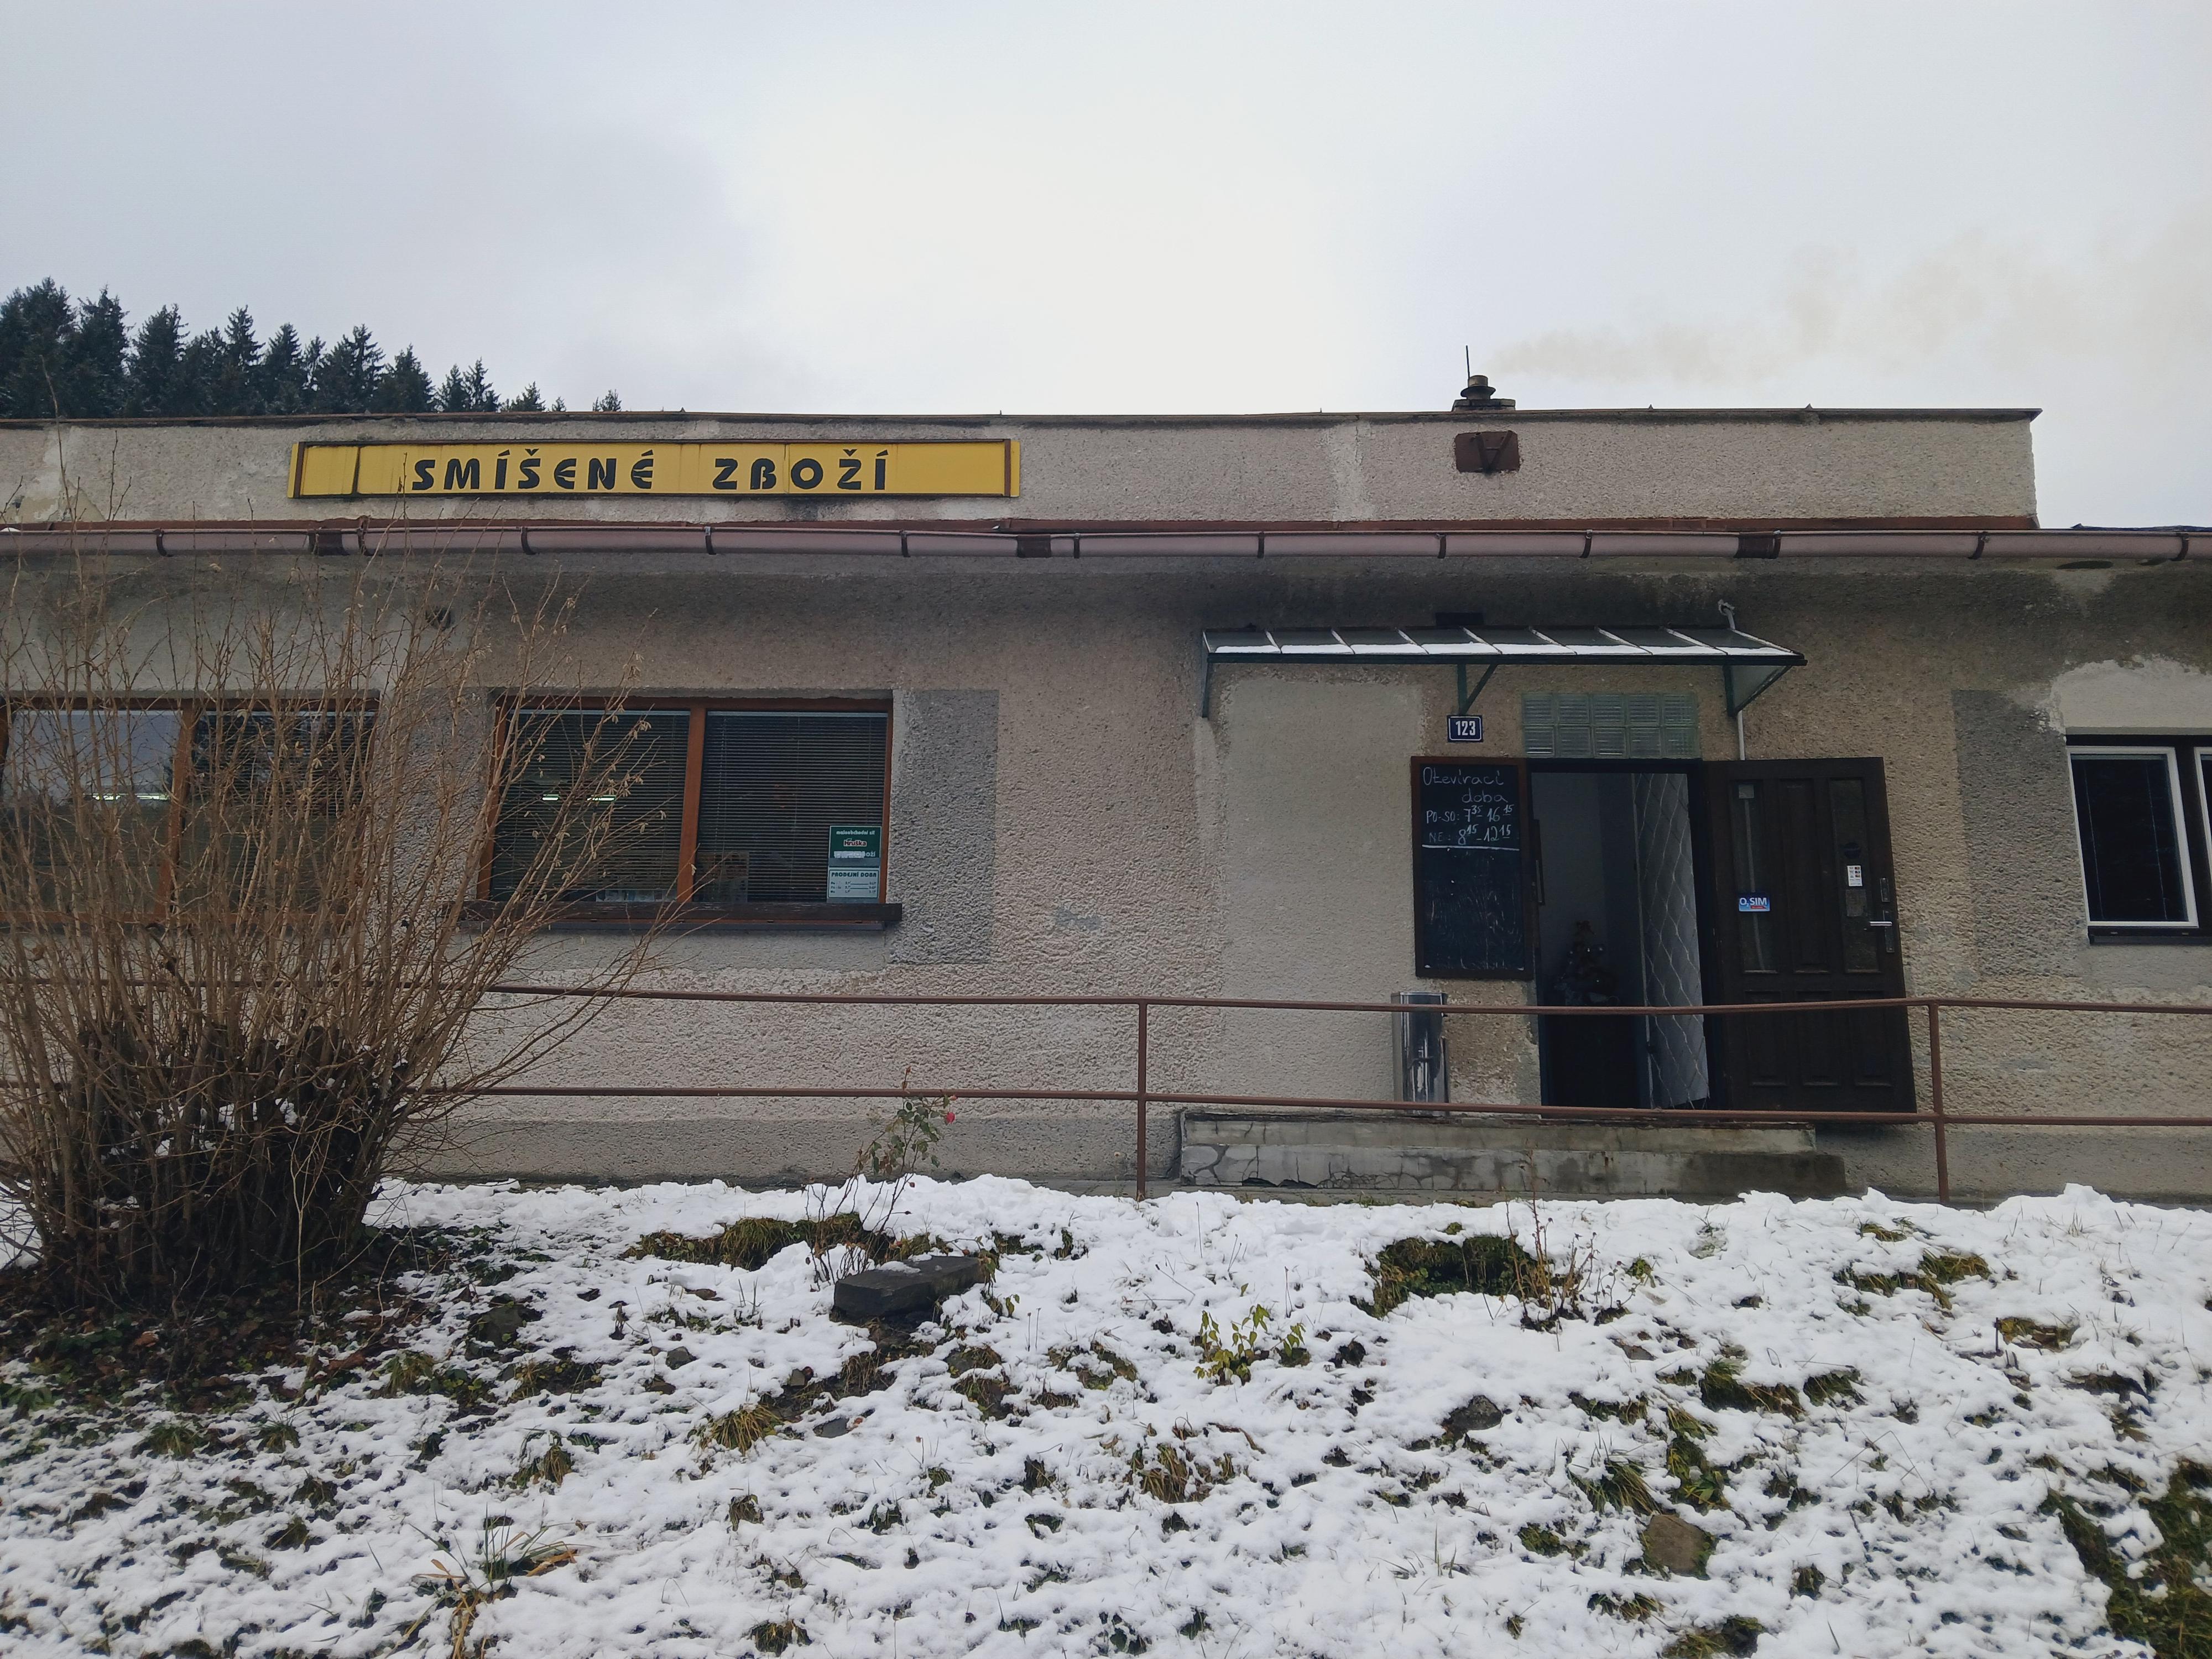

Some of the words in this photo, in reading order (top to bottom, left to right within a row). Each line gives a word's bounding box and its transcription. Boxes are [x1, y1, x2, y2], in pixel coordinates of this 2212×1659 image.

[411, 448, 654, 490] SMÍŠENÉ
[712, 448, 888, 491] ZBOŽÍ
[1455, 721, 1476, 735] 123
[1462, 787, 1509, 803] doba
[1749, 897, 1767, 905] SIM
